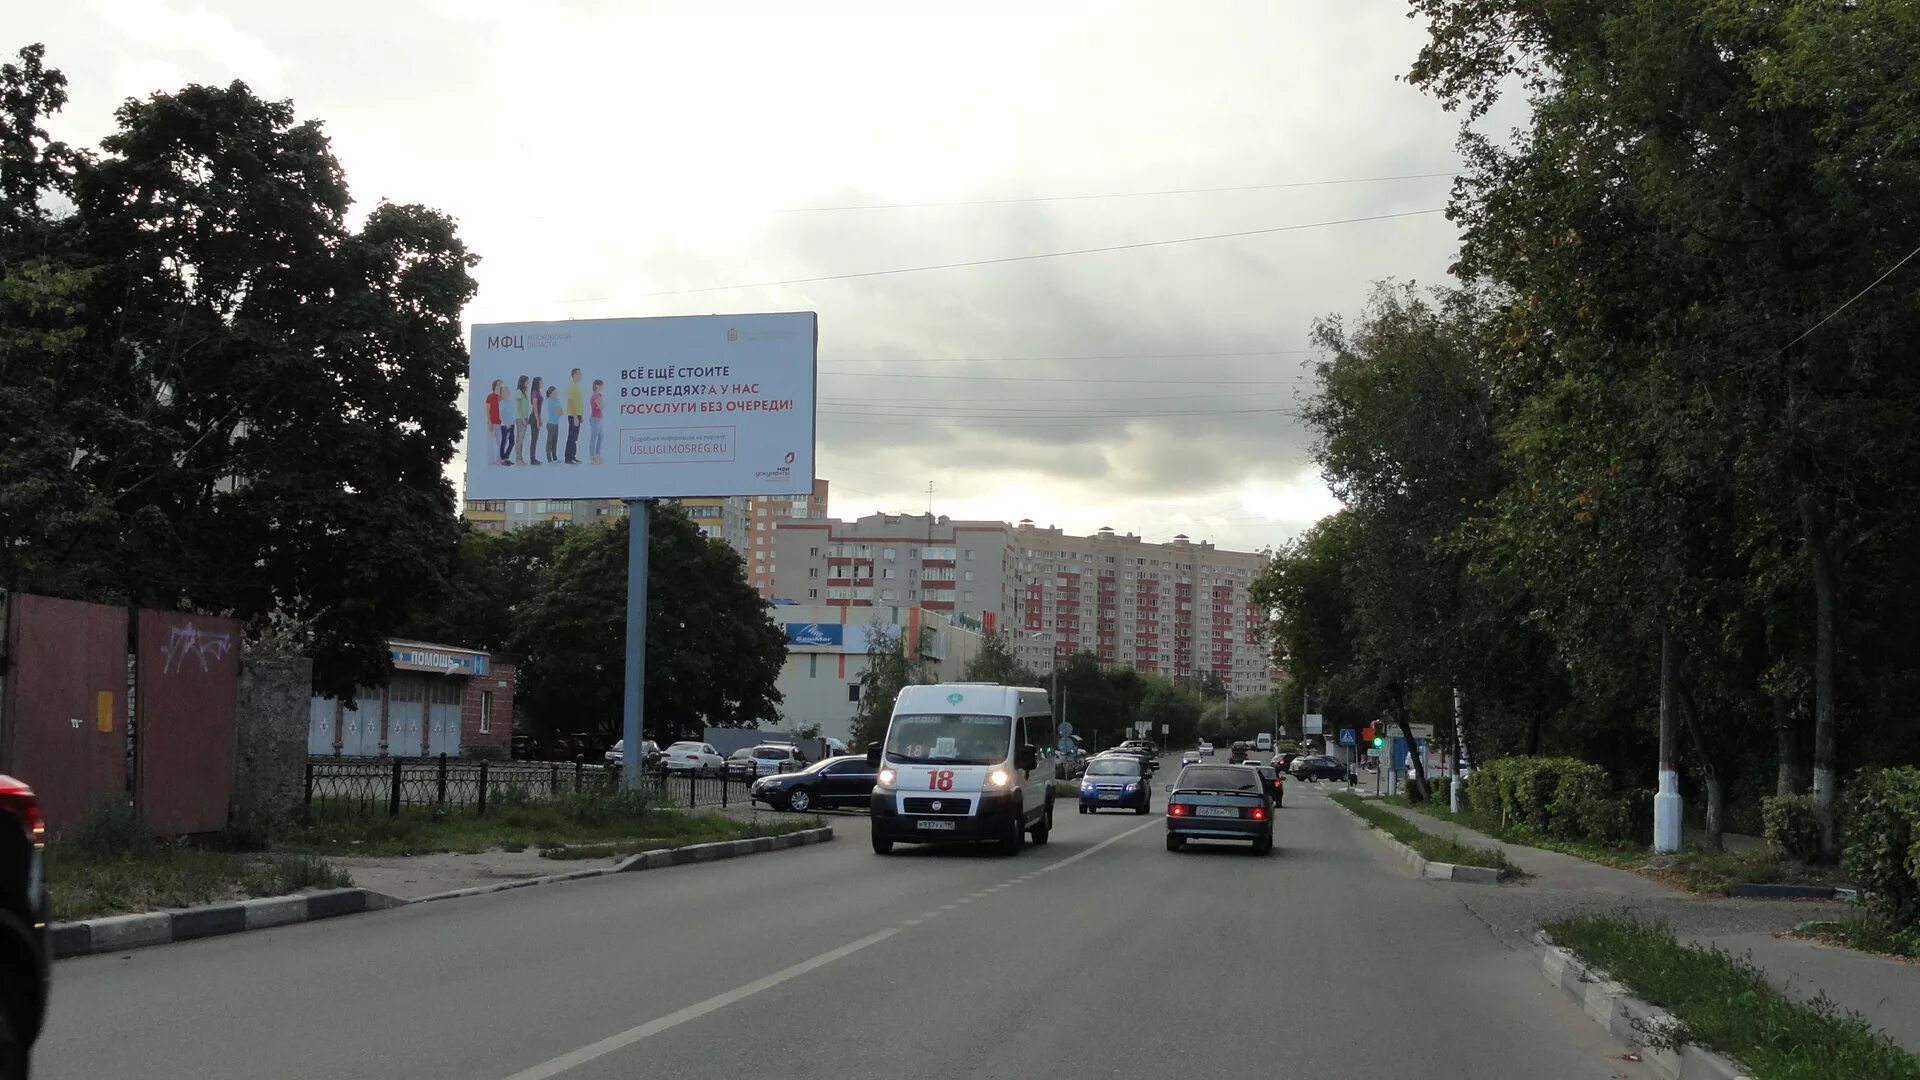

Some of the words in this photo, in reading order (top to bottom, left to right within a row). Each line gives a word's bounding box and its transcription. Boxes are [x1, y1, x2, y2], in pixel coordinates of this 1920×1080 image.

[488, 335, 524, 350] МФЦ
[621, 366, 644, 379] ВСЁ
[647, 365, 675, 379] ЕЩЁ
[678, 366, 730, 377] СТОИТЕ
[621, 387, 628, 397] В
[631, 385, 707, 397] ОЧЕРЕДЯХ?
[708, 385, 717, 395] А
[720, 384, 729, 394] У
[732, 383, 759, 394] НАС
[620, 402, 697, 414] ГОСУСЛУГИ
[700, 401, 723, 412] БЕЗ
[726, 399, 793, 412] ОЧЕРЕДИ!
[629, 443, 727, 455] USLUGI.MOSREG.RU
[411, 650, 454, 668] ПОМОЩЬ
[905, 743, 922, 757] 18
[927, 769, 955, 791] 18
